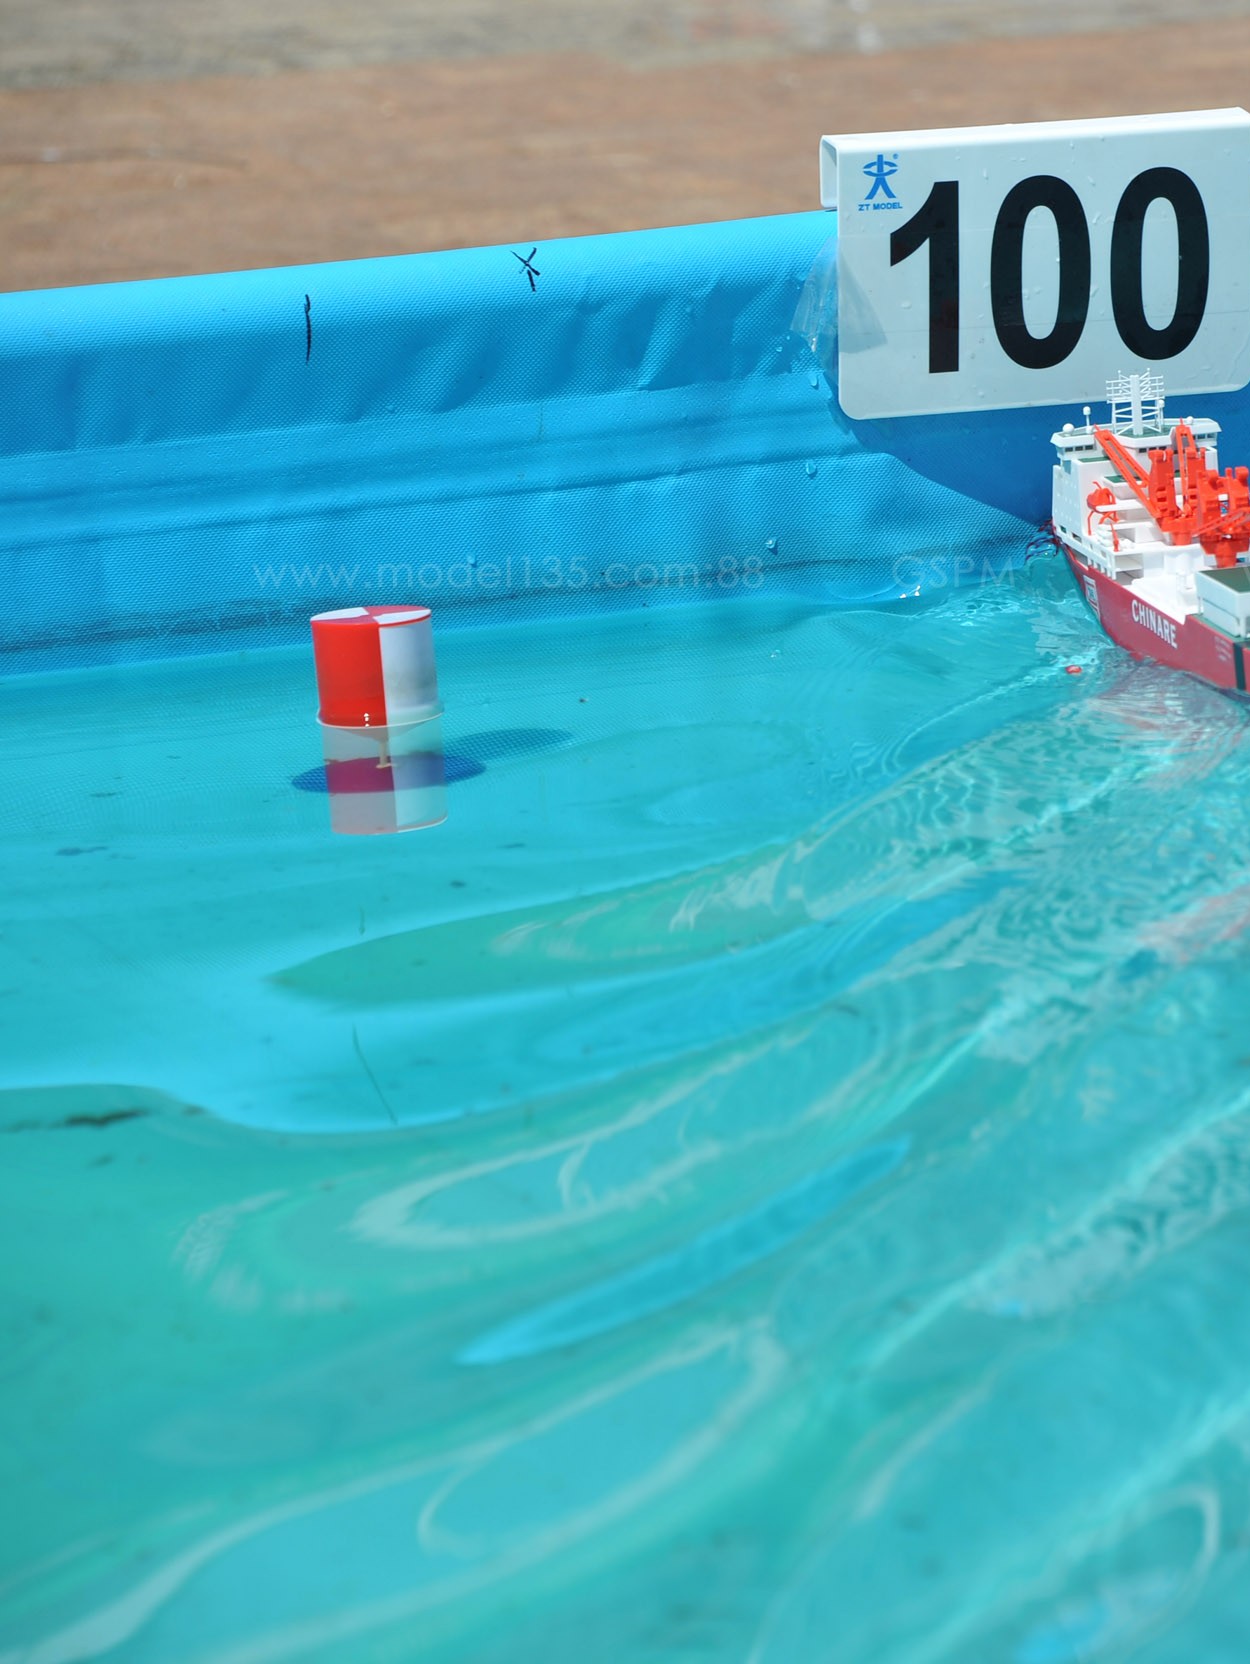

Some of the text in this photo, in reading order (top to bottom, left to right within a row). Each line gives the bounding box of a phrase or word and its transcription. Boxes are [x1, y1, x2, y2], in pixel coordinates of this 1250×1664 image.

[858, 202, 903, 211] ZT MODEL
[890, 166, 1210, 374] 100
[1131, 599, 1178, 649] CHINARE
